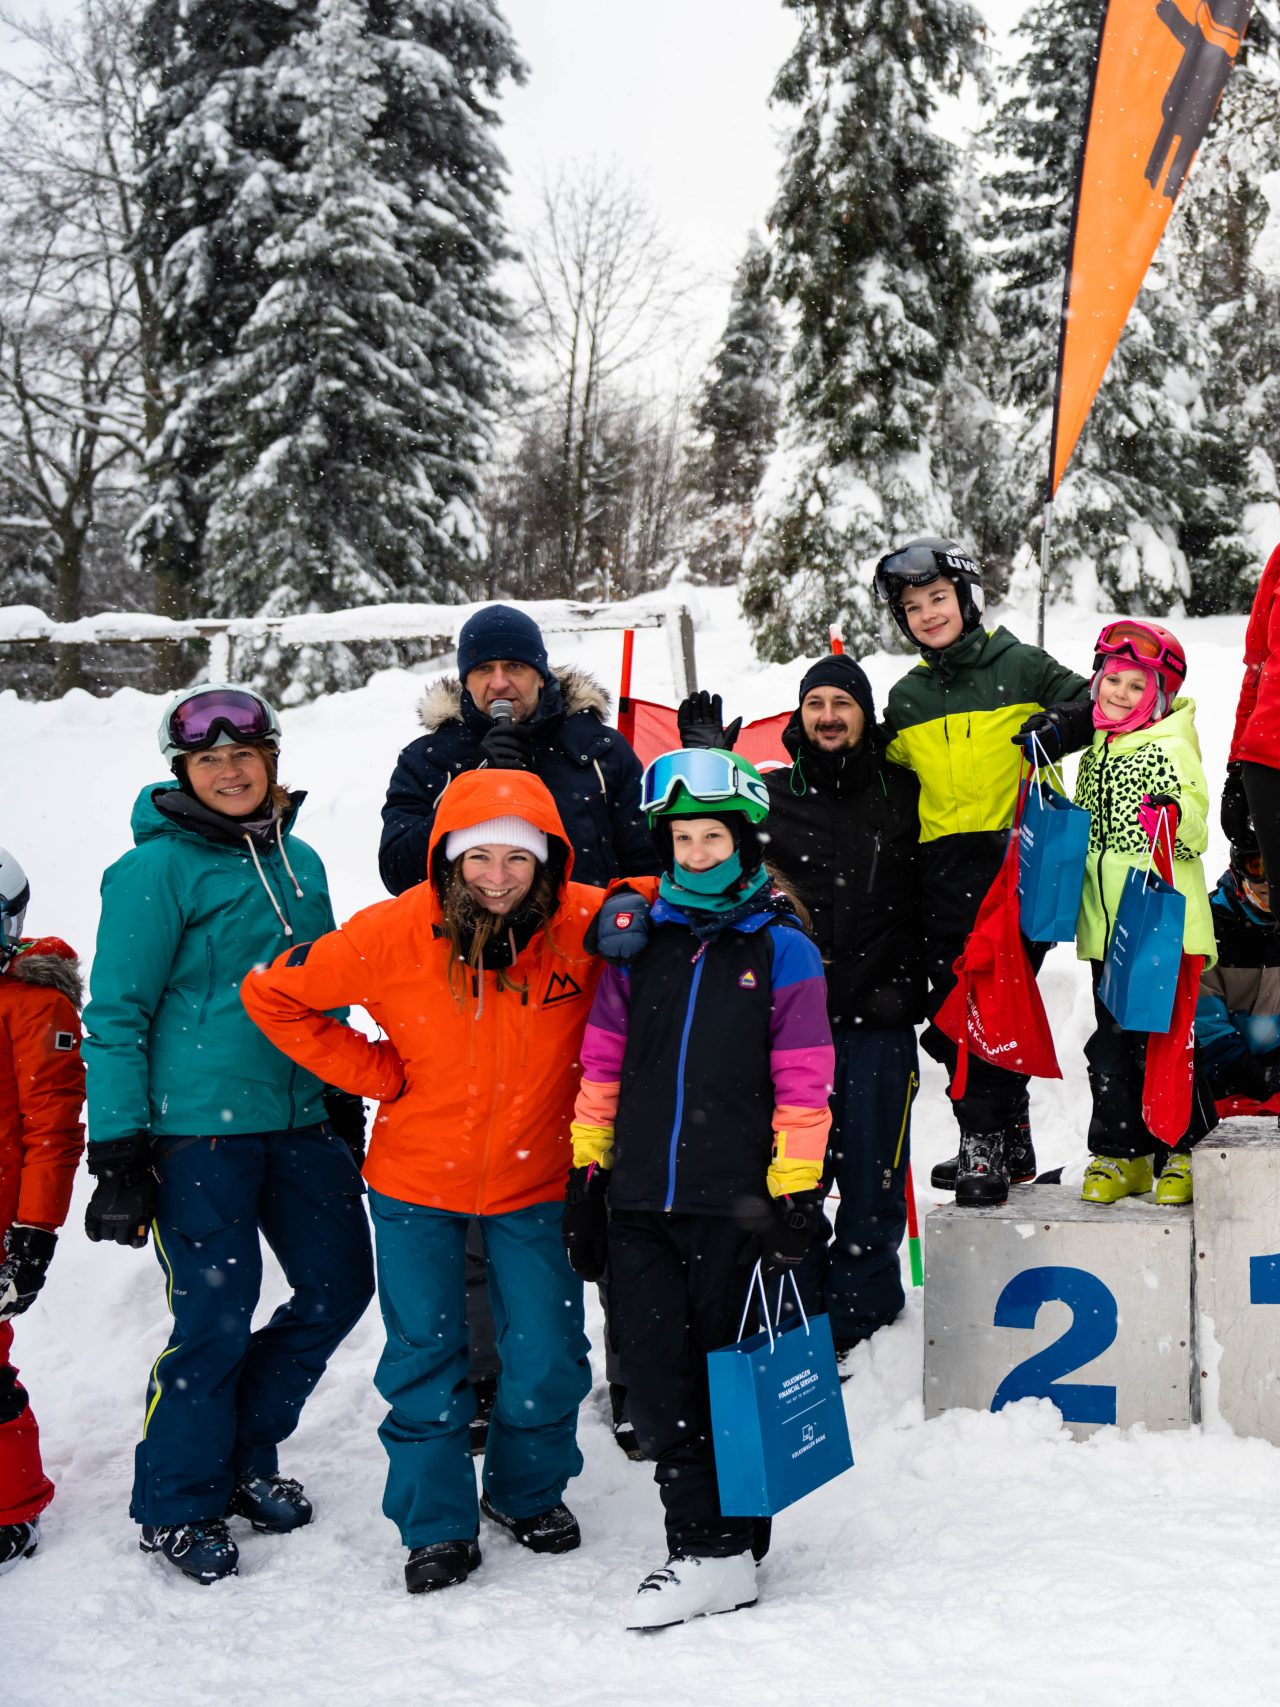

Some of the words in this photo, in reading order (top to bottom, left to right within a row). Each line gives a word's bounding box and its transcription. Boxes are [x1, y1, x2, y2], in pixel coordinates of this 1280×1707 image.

[1166, 653, 1184, 672] uvex
[991, 1266, 1118, 1425] 2
[778, 1383, 801, 1400] FINANCIAL
[799, 1373, 819, 1389] SERVICES
[782, 1368, 811, 1389] VOLKSWAGEN
[791, 1440, 816, 1459] VOLKSWAGEN
[815, 1434, 826, 1445] BANK
